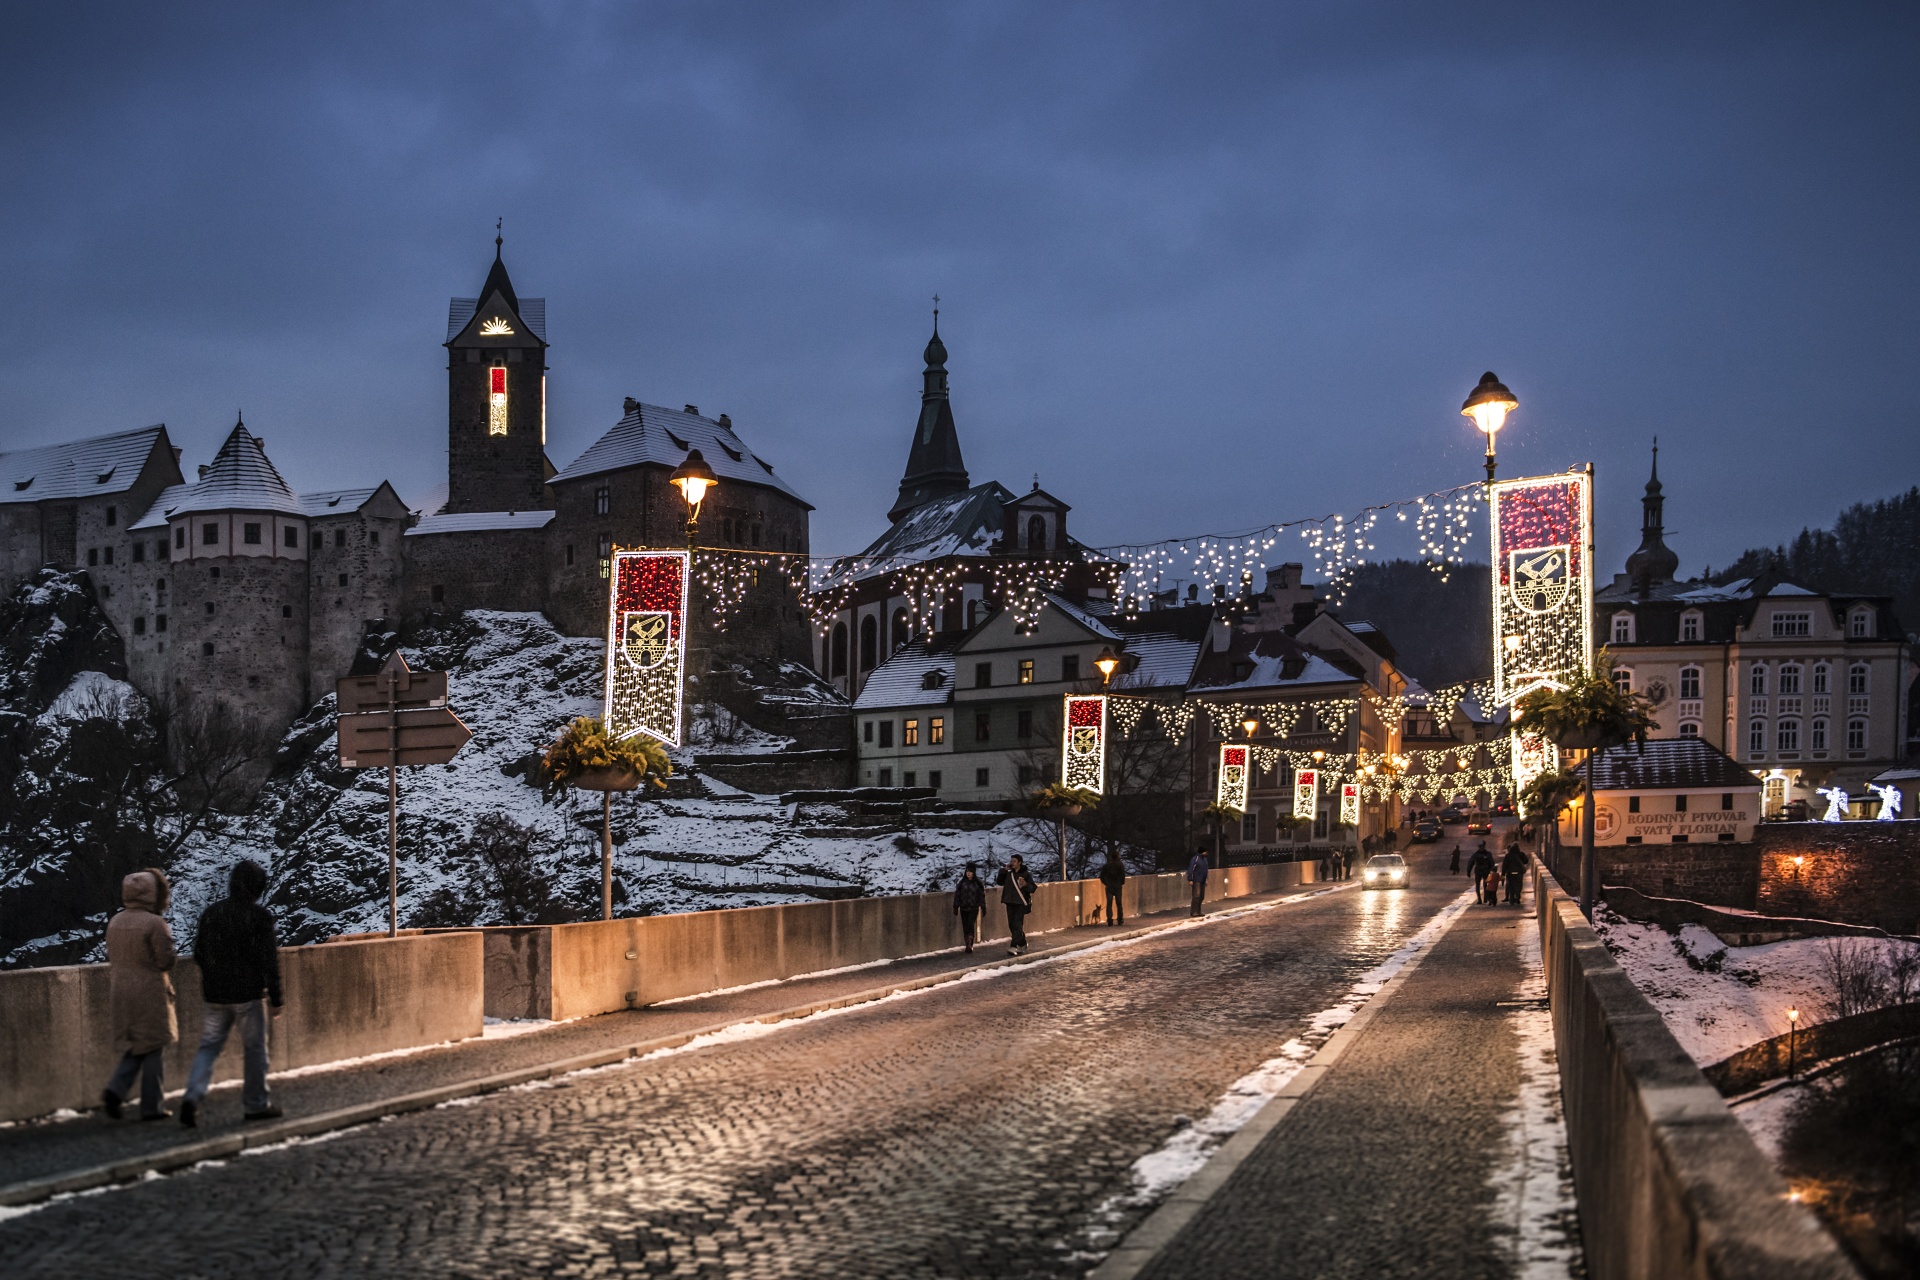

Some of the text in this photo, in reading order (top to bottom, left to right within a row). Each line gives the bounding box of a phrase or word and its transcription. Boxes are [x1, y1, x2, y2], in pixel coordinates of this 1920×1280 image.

[1271, 736, 1337, 748] INFO CHANG
[1628, 811, 1747, 824] RODINNÝ PIVOVAR
[1634, 823, 1737, 835] SVATÝ FLORIAN
